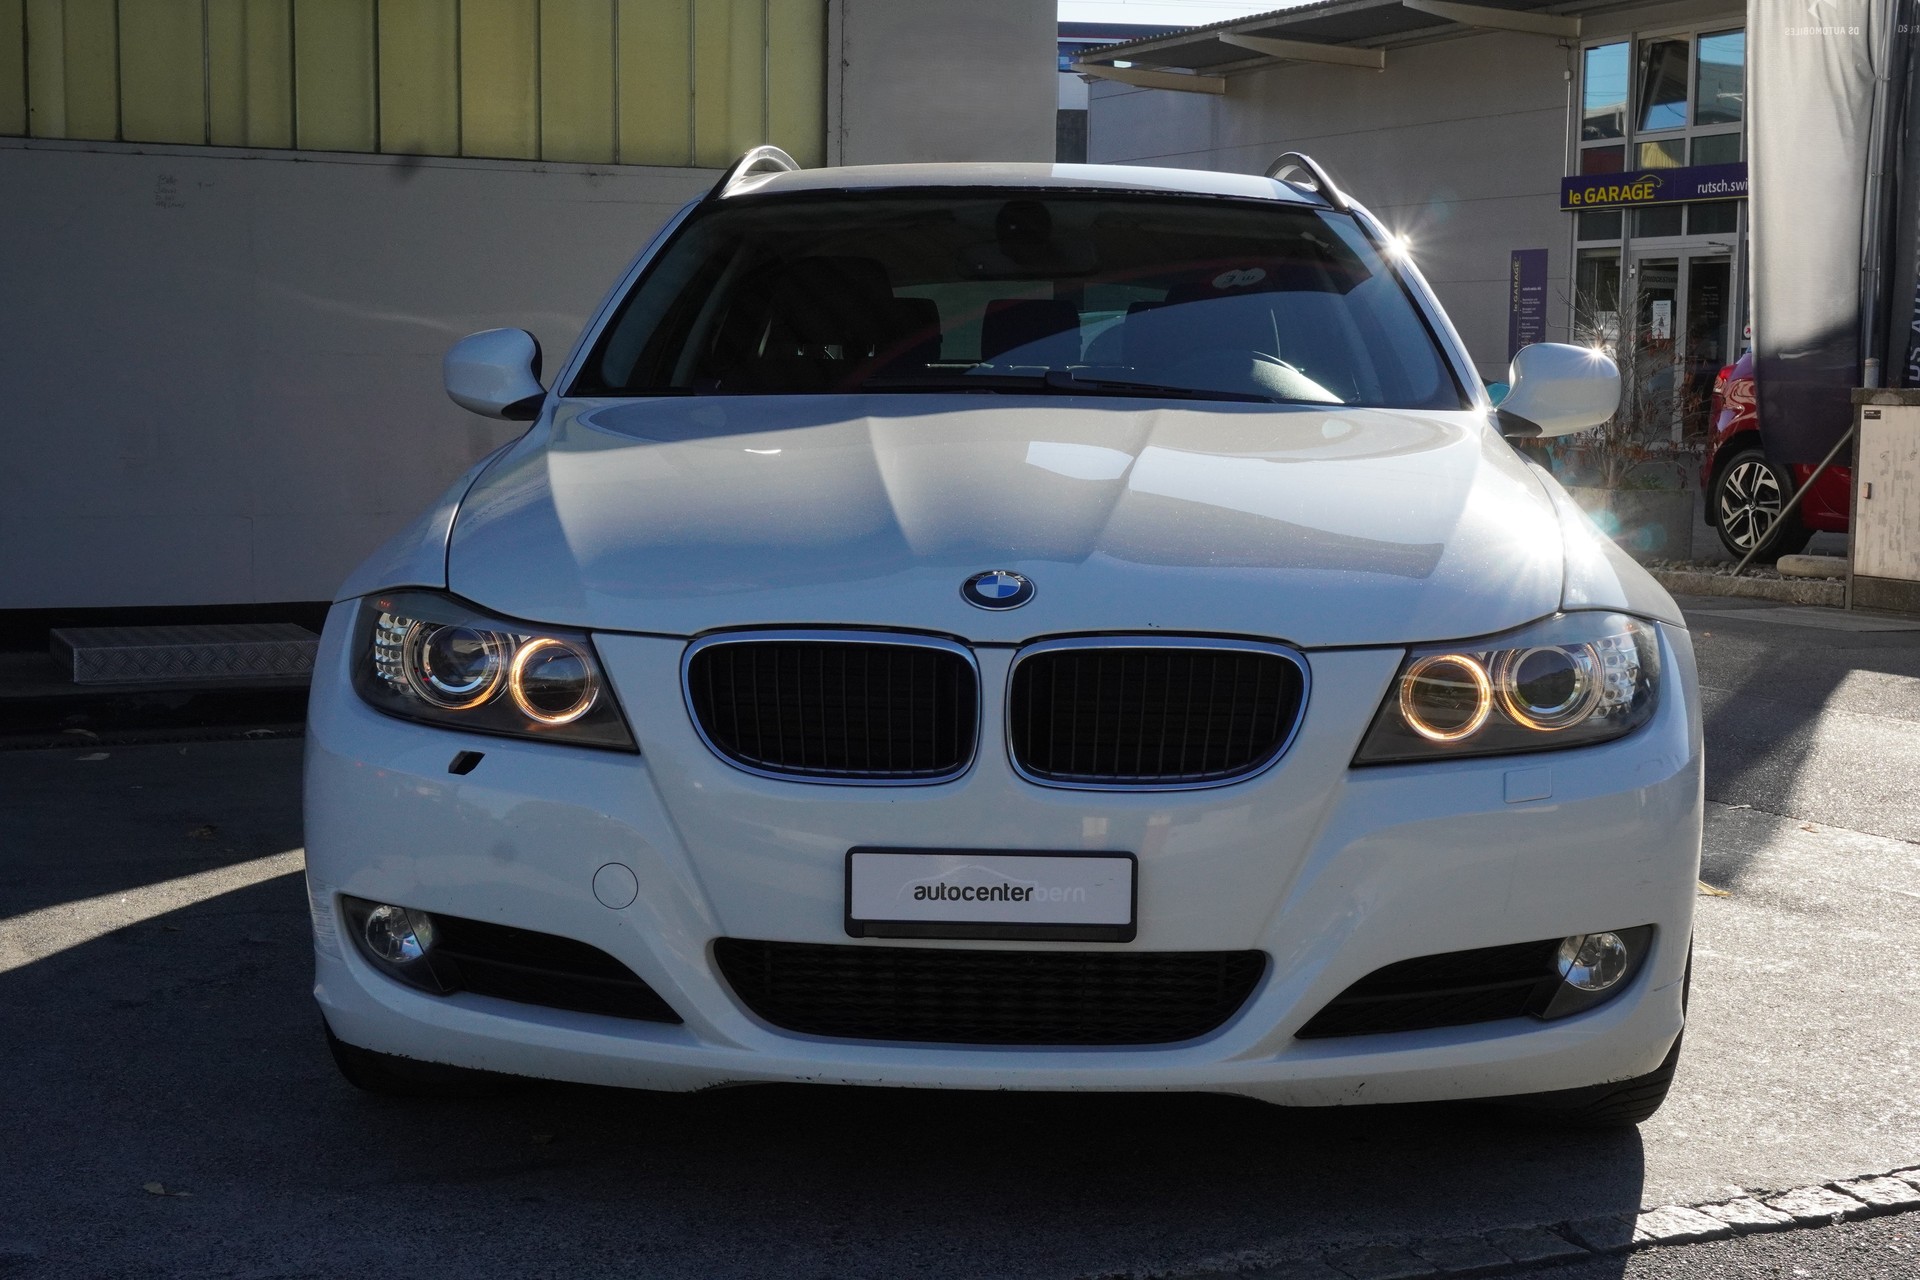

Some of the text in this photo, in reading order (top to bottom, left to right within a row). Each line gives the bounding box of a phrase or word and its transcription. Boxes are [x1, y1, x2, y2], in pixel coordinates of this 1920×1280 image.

[1897, 24, 1908, 33] DS
[1569, 183, 1655, 205] le GARAGE
